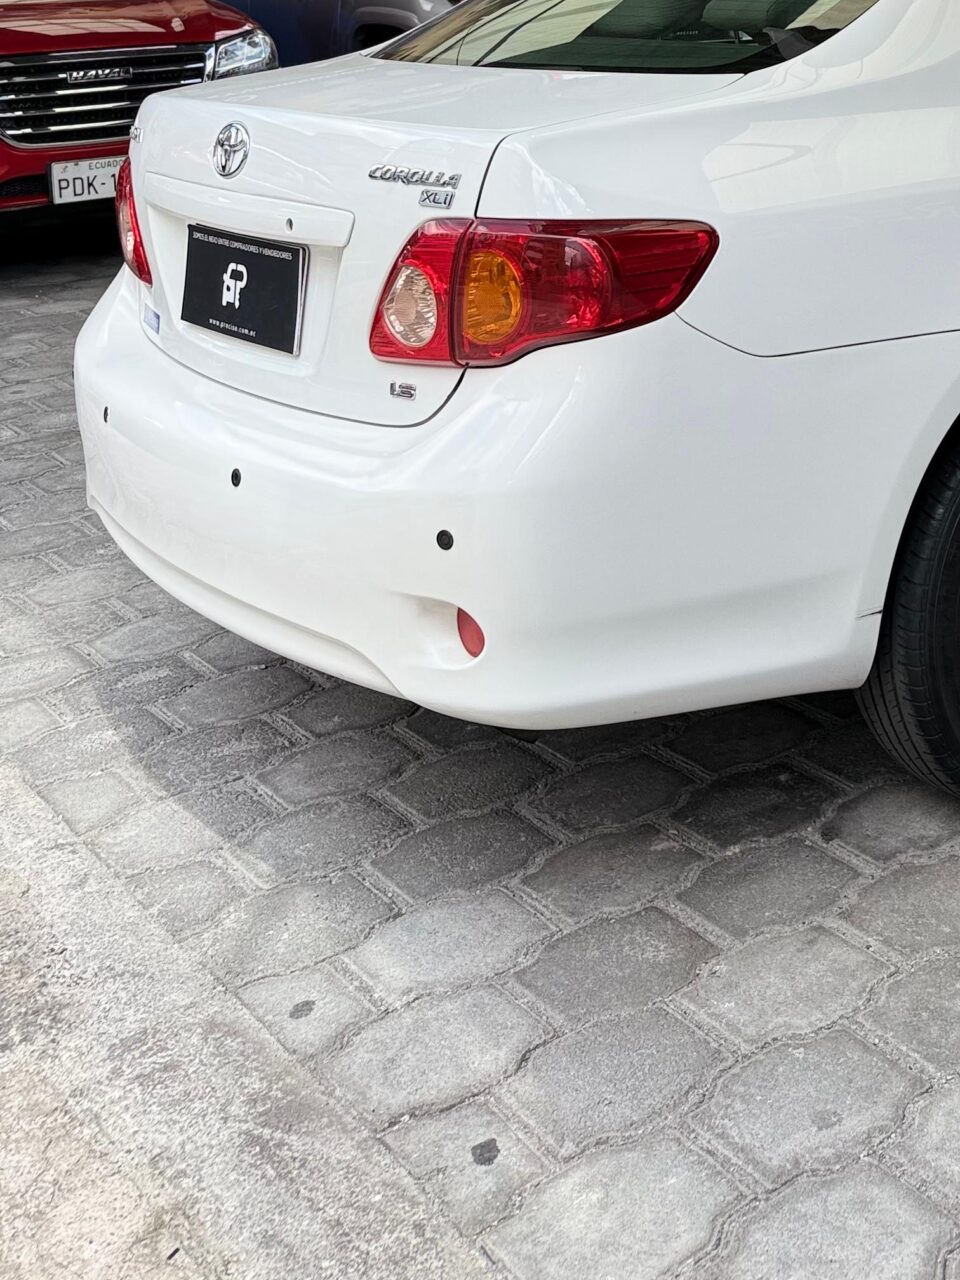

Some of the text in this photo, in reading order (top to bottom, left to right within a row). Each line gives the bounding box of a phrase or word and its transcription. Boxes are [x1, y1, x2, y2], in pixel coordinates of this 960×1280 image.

[72, 68, 129, 80] HAVAL
[88, 159, 124, 171] ECUADO
[58, 173, 117, 199] PDK-1
[368, 163, 462, 189] COROLLA
[230, 240, 259, 254] COMPRADORES
[263, 248, 293, 260] VENDEDORES
